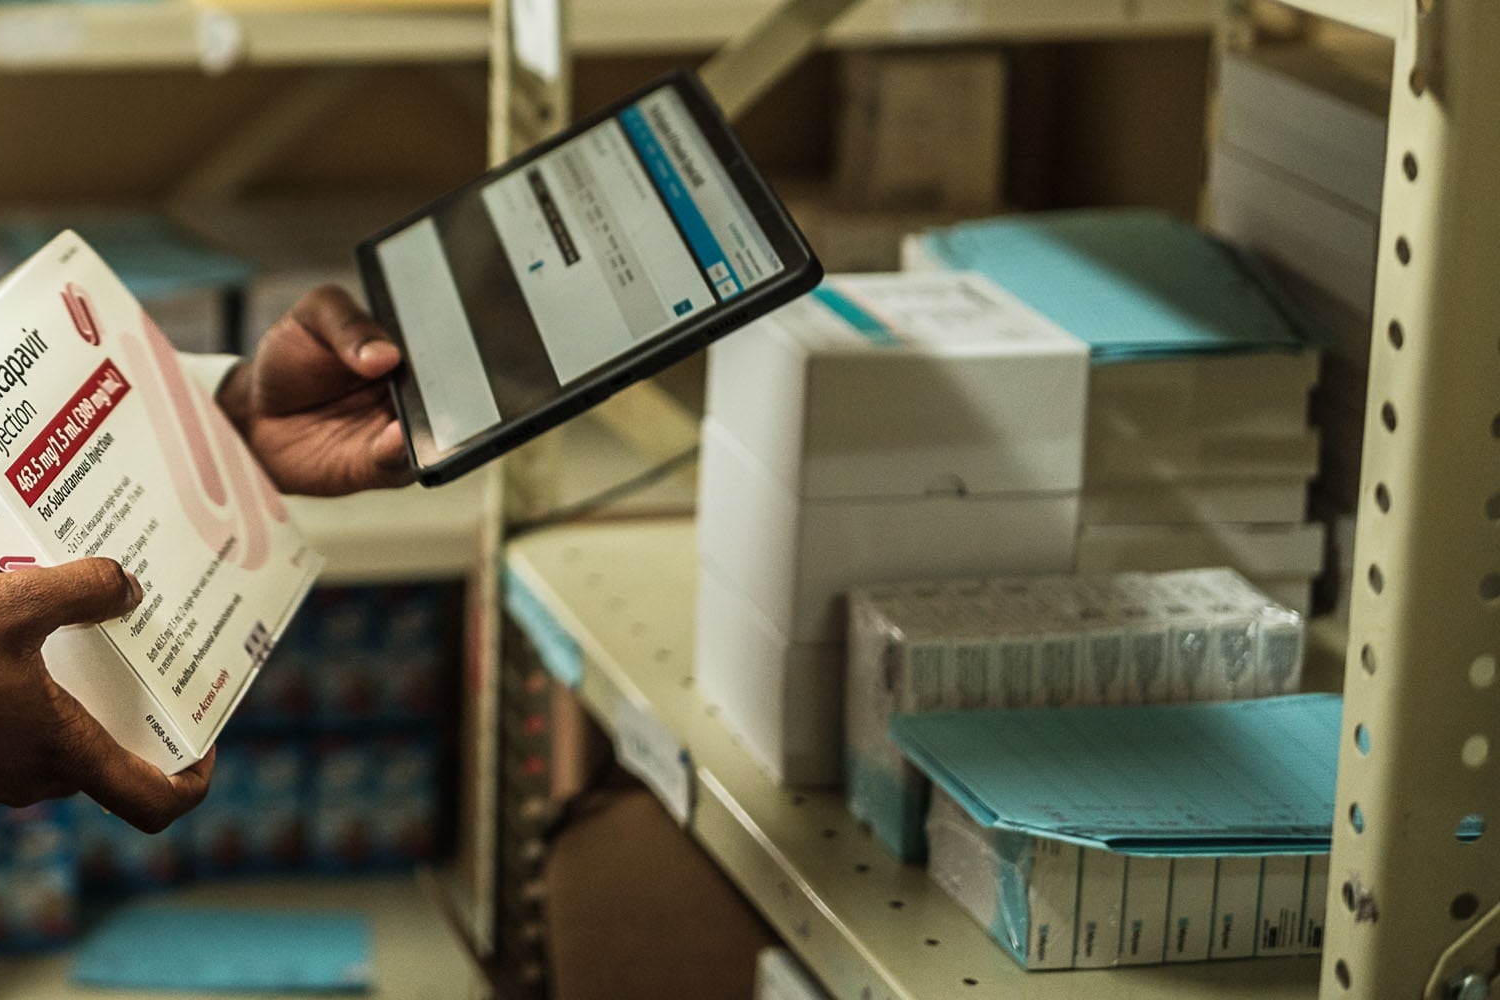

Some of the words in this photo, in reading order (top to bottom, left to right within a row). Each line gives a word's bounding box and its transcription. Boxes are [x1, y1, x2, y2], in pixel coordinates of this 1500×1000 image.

[90, 368, 124, 409] mg/mL)
[64, 416, 82, 440] mL
[72, 398, 96, 429] (309
[43, 428, 70, 467] mg/1.5
[16, 457, 44, 492] 463.5
[38, 506, 54, 522] For
[48, 459, 92, 510] Subcutaneous
[85, 432, 115, 465] Injection
[54, 516, 75, 540] Contents
[142, 594, 164, 622] Information
[146, 646, 159, 663] Both
[154, 634, 168, 651] 463.5
[172, 686, 182, 697] For
[178, 660, 199, 690] Healthcare
[192, 708, 202, 725] For
[199, 690, 216, 712] Access
[212, 667, 230, 693] Supply
[146, 714, 184, 761] 61958-3405-1
